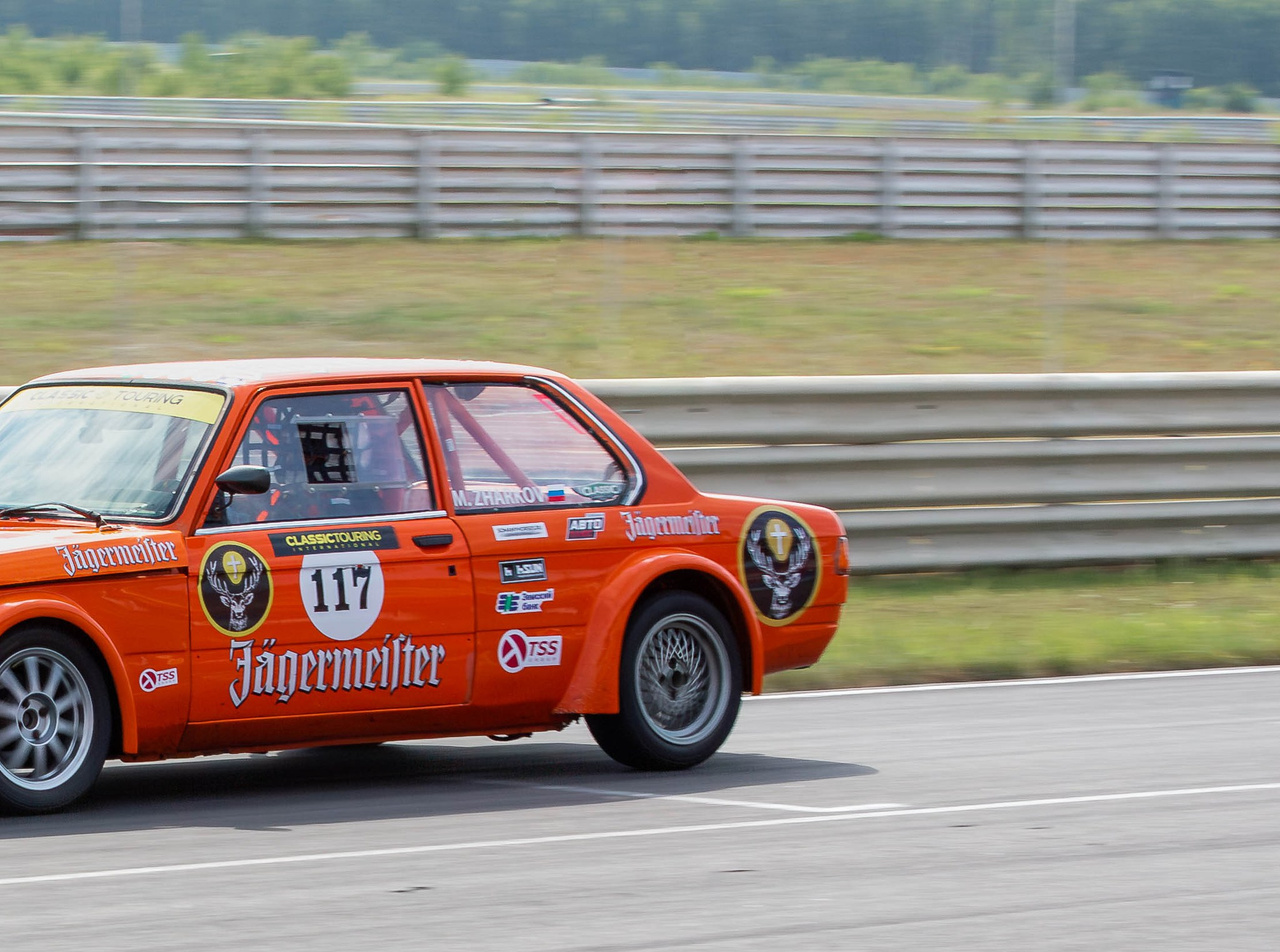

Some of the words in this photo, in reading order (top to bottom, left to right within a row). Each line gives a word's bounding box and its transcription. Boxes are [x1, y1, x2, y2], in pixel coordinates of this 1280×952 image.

[30, 390, 94, 401] CLASSIC
[114, 389, 184, 405] TOURING
[452, 490, 471, 507] M.
[474, 486, 546, 505] ZHARKOV
[620, 510, 720, 541] Jägermeister
[285, 530, 382, 547] CLASSICTOURING
[292, 542, 380, 552] INTERNATIONAL
[55, 538, 177, 576] Jägermeister
[311, 566, 371, 612] 117
[528, 640, 559, 656] TSS
[157, 670, 176, 682] TSS
[229, 633, 446, 708] Jägermeister
